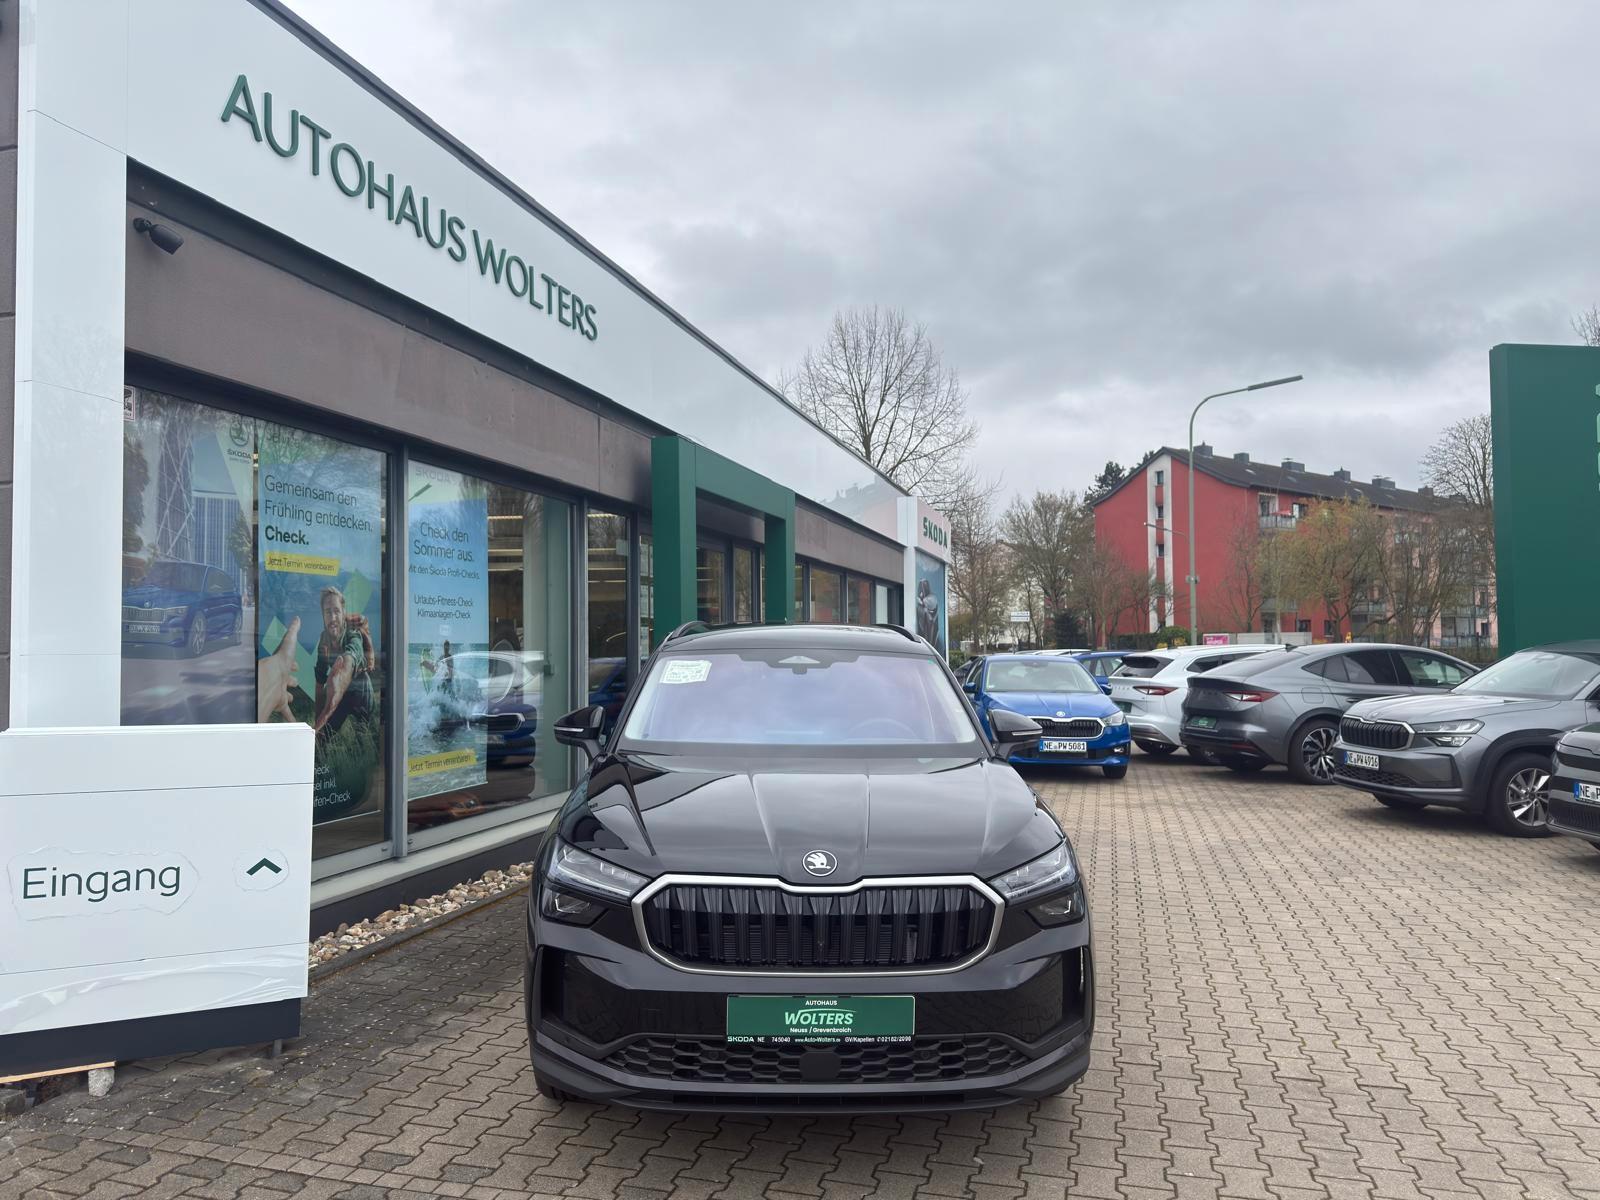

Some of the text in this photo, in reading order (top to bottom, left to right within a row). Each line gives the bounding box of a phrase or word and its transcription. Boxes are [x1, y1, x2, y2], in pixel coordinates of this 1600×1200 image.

[219, 74, 598, 341] AUTOHAUS WOLTERS
[264, 474, 358, 507] Gemeinsam den
[264, 498, 374, 533] Frühling entdecken.
[264, 524, 310, 545] Check.
[420, 521, 469, 543] Check den
[413, 539, 455, 559] Sommer
[283, 557, 303, 569] Termin
[1044, 741, 1053, 750] NE
[1058, 741, 1067, 750] PW
[425, 759, 442, 770] Termin
[1579, 784, 1590, 798] NE
[22, 865, 181, 903] Eingang
[784, 1009, 855, 1025] WOLTERS
